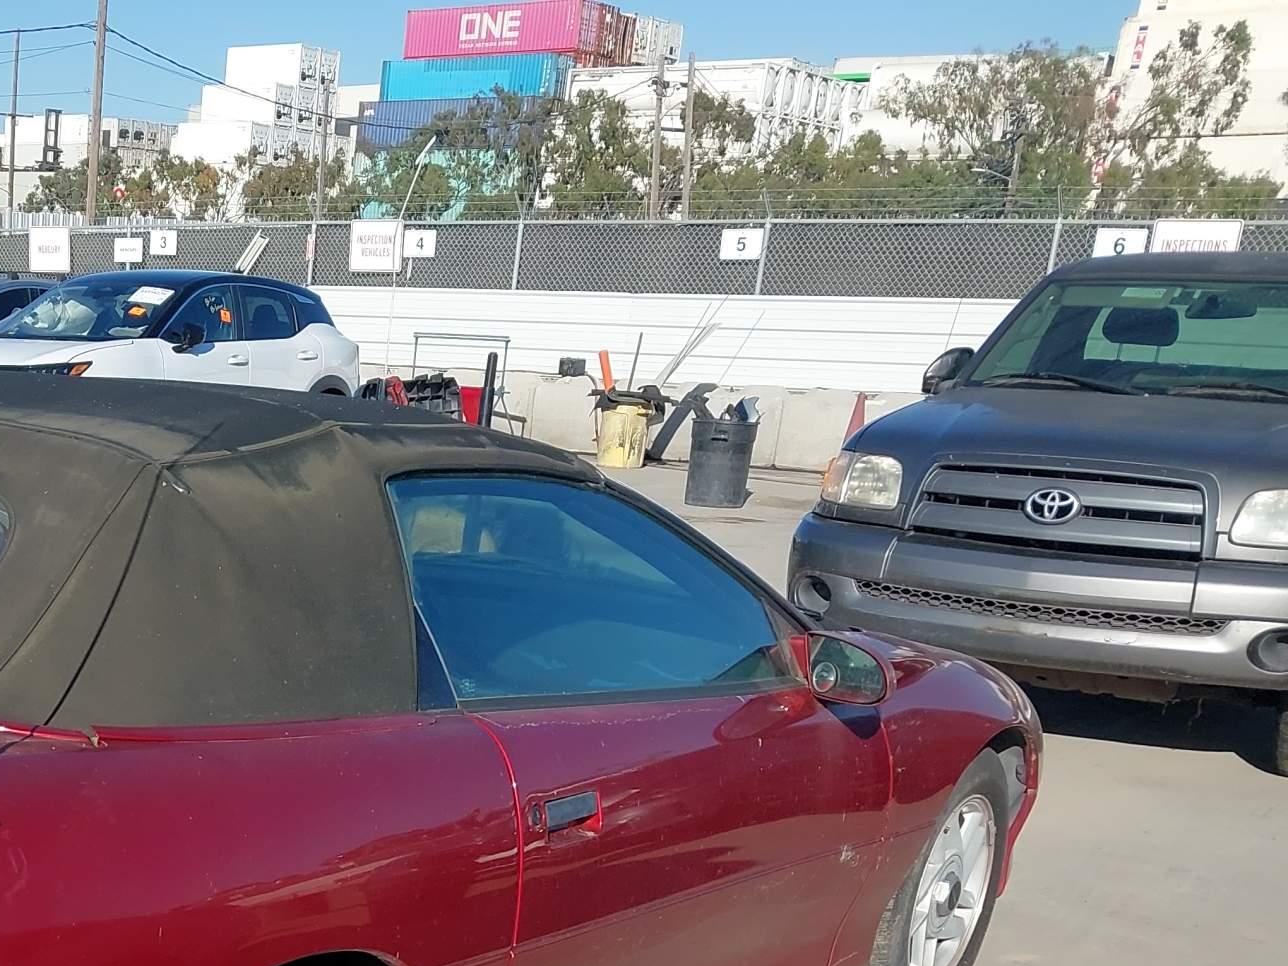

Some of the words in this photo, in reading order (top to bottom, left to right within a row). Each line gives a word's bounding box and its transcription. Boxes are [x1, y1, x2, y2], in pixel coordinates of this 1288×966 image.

[459, 10, 522, 41] ONE
[160, 236, 167, 249] 3
[416, 237, 424, 250] 4
[737, 236, 747, 252] 5
[1113, 237, 1127, 255] 6
[1160, 239, 1228, 253] INSPECTIONS
[361, 247, 391, 257] VEHICLES
